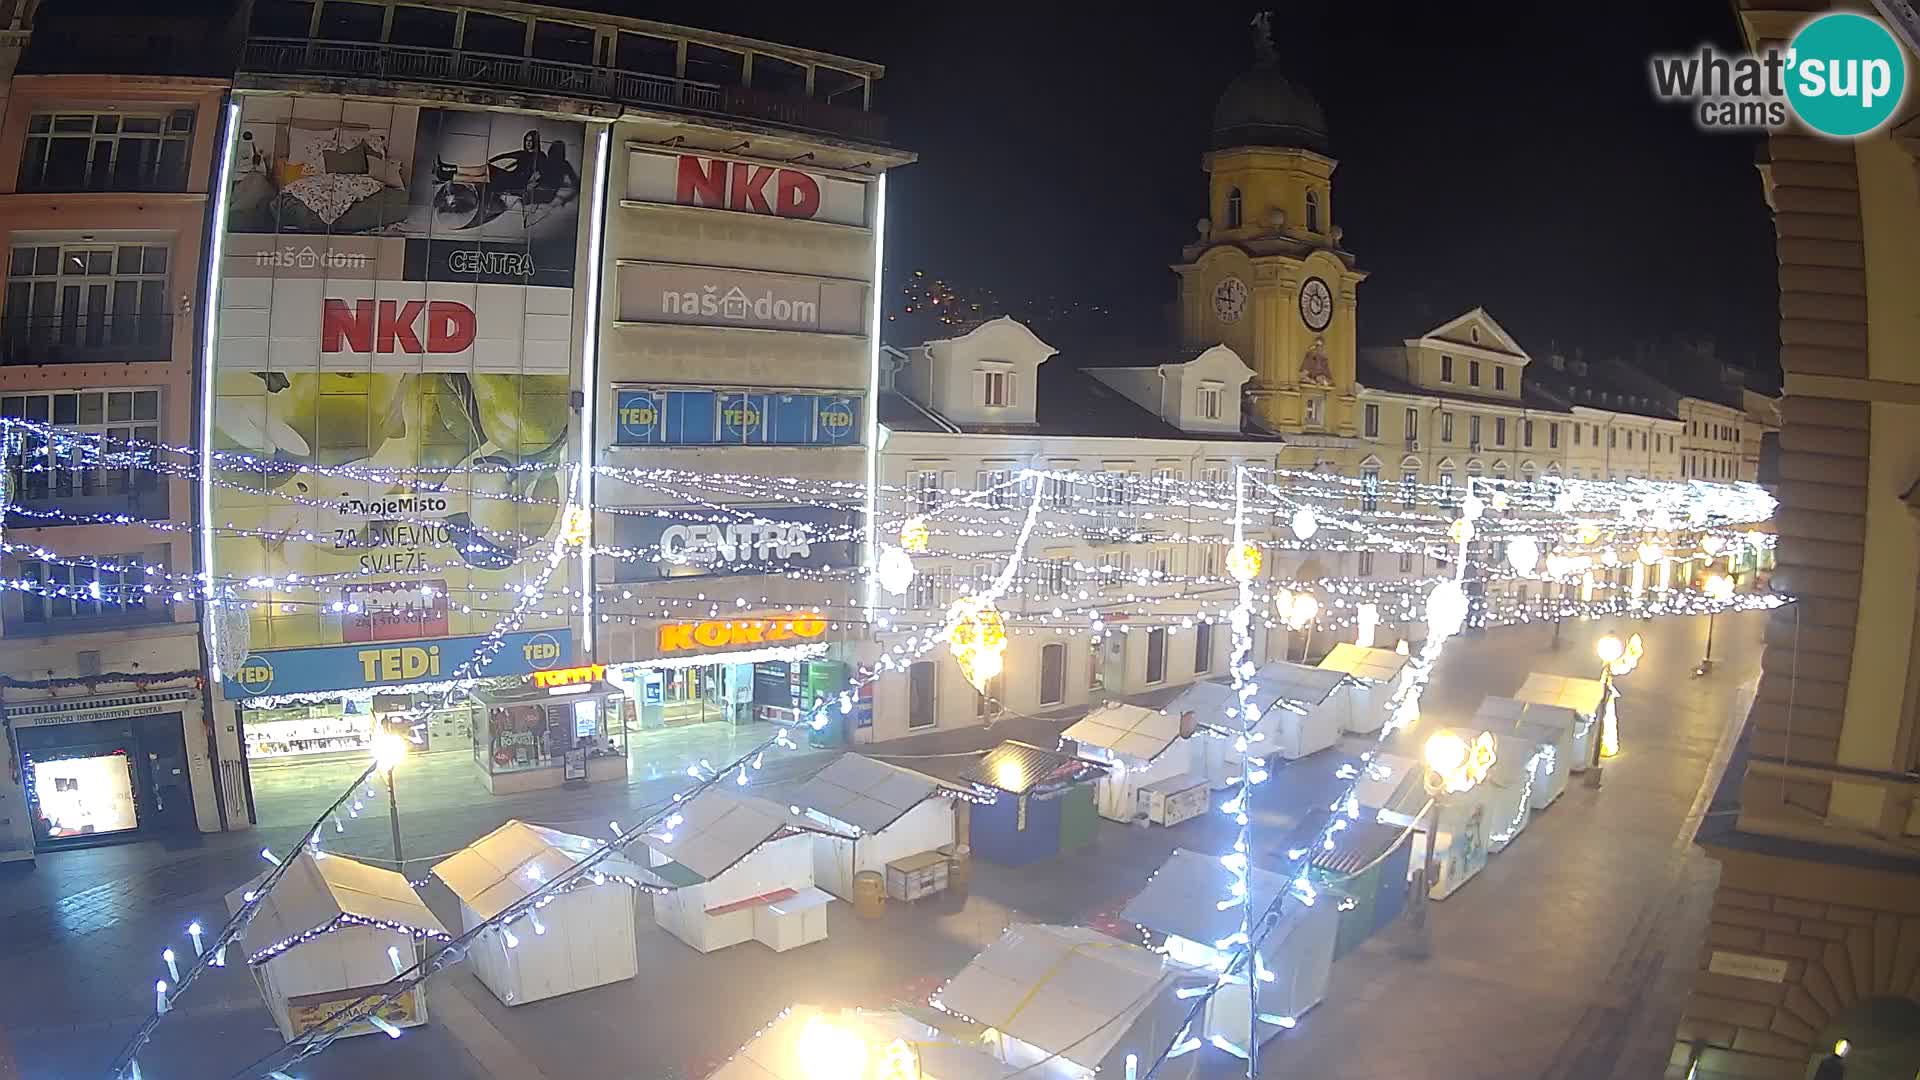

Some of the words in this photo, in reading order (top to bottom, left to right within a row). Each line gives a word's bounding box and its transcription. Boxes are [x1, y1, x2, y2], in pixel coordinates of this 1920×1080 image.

[676, 155, 820, 219] NKD
[255, 246, 295, 268] naš
[320, 246, 367, 270] dom
[448, 250, 535, 276] CENTRA
[662, 284, 718, 316] naš
[754, 290, 817, 323] dom
[321, 298, 477, 354] NKD
[619, 408, 658, 425] TEDi
[723, 409, 760, 426] TEDi
[339, 497, 447, 516] #TvojeMisto
[334, 528, 357, 549] ZA
[367, 525, 451, 549] DNEVNO
[659, 521, 811, 564] CENTRA
[360, 547, 427, 574] SVJEŽE
[659, 613, 828, 652] KORZO
[359, 645, 440, 682] TEDi
[523, 643, 560, 660] TEDi
[237, 662, 273, 683] TEDi
[534, 664, 605, 688] TOMMY
